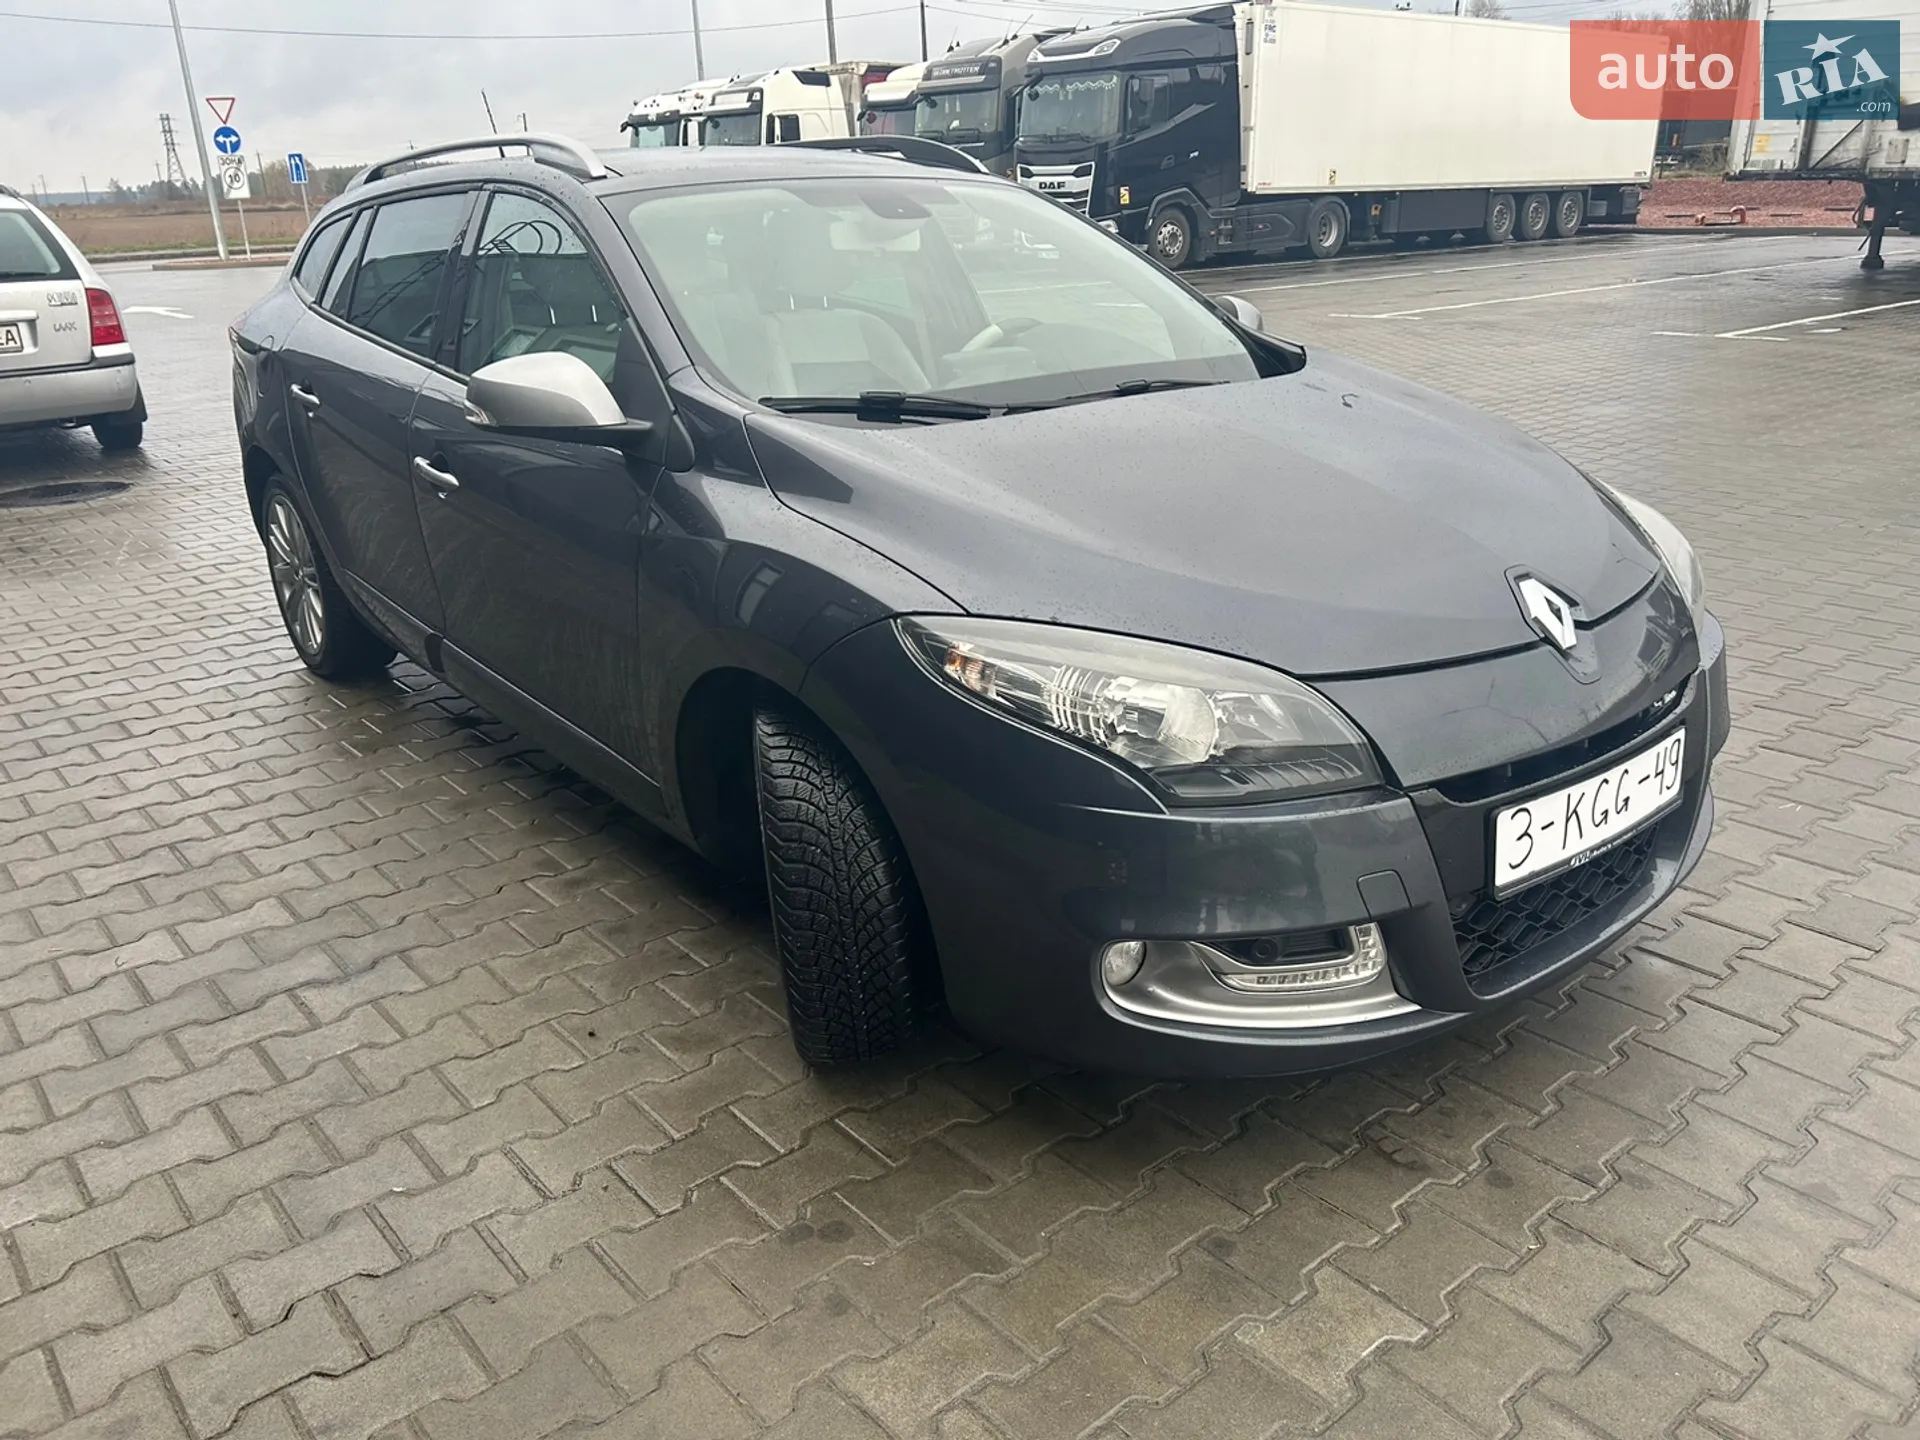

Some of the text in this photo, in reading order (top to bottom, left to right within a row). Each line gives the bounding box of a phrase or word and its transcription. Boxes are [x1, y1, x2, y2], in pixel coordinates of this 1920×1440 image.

[228, 173, 241, 184] 10
[1039, 181, 1066, 190] DAF
[1508, 737, 1682, 870] 3-KGG-49
